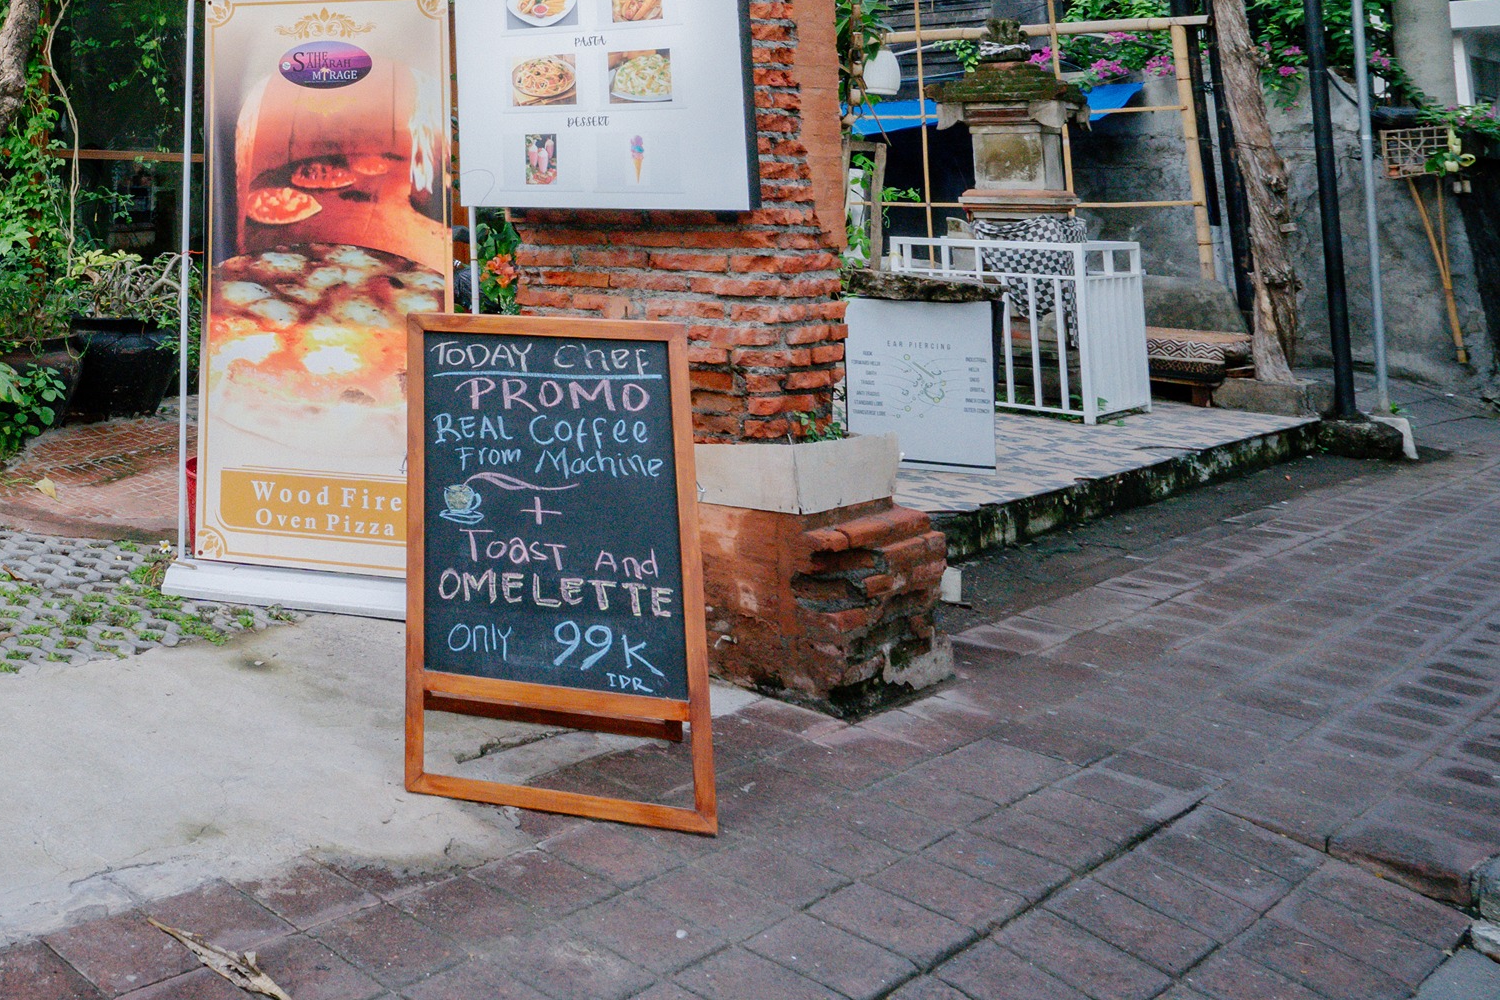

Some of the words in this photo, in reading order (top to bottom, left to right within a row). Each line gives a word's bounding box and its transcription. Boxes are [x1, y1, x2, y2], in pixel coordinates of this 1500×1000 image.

[574, 34, 607, 47] PASTA
[307, 52, 328, 60] THE
[567, 116, 610, 128] DESSERT
[430, 341, 533, 372] TODAY
[908, 341, 952, 350] PIERCING
[455, 377, 650, 413] PROMO
[432, 412, 513, 445] REAL
[529, 414, 648, 453] Coffee
[455, 446, 522, 472] From
[534, 448, 664, 479] Machine
[251, 480, 330, 506] Wood
[341, 487, 402, 512] Fire
[256, 508, 316, 530] Oven
[326, 513, 395, 537] Pizza
[438, 567, 674, 618] OMELETTE
[606, 672, 653, 693] IDR
